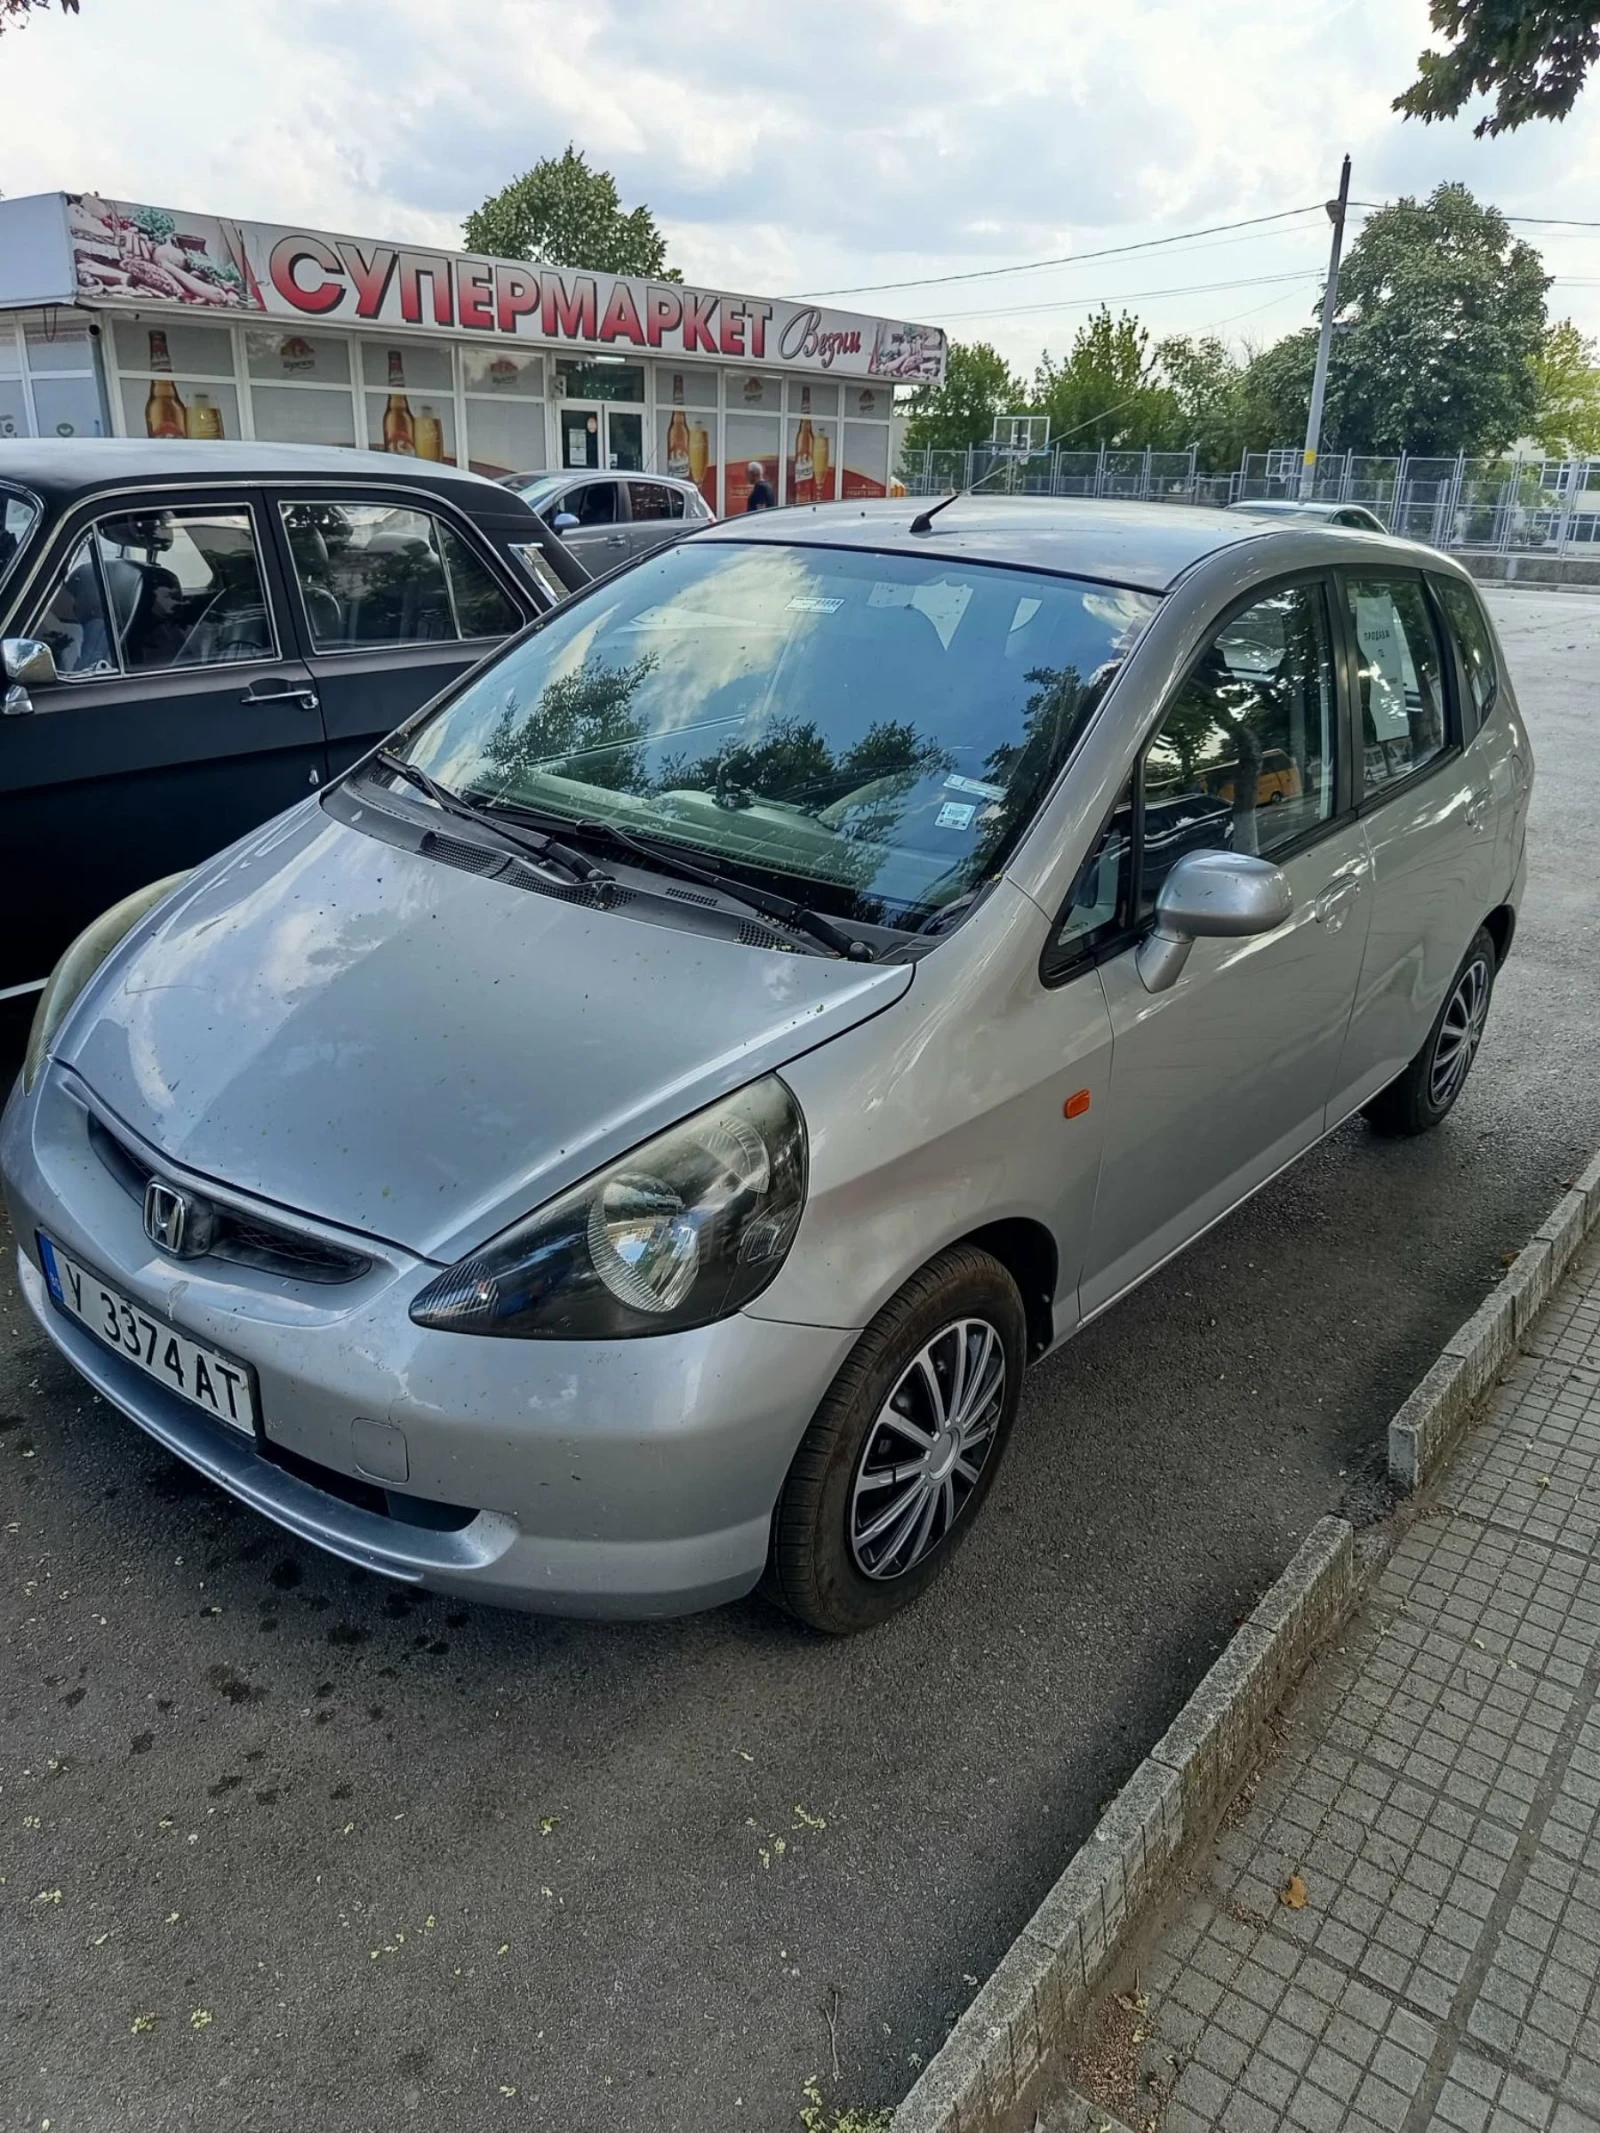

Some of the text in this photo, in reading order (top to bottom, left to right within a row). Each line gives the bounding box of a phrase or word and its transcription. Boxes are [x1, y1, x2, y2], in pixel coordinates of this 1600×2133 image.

[269, 235, 862, 369] СУПЕРМАРКЕТ Везни
[100, 1291, 185, 1388] 3374
[196, 1353, 241, 1419] AT
